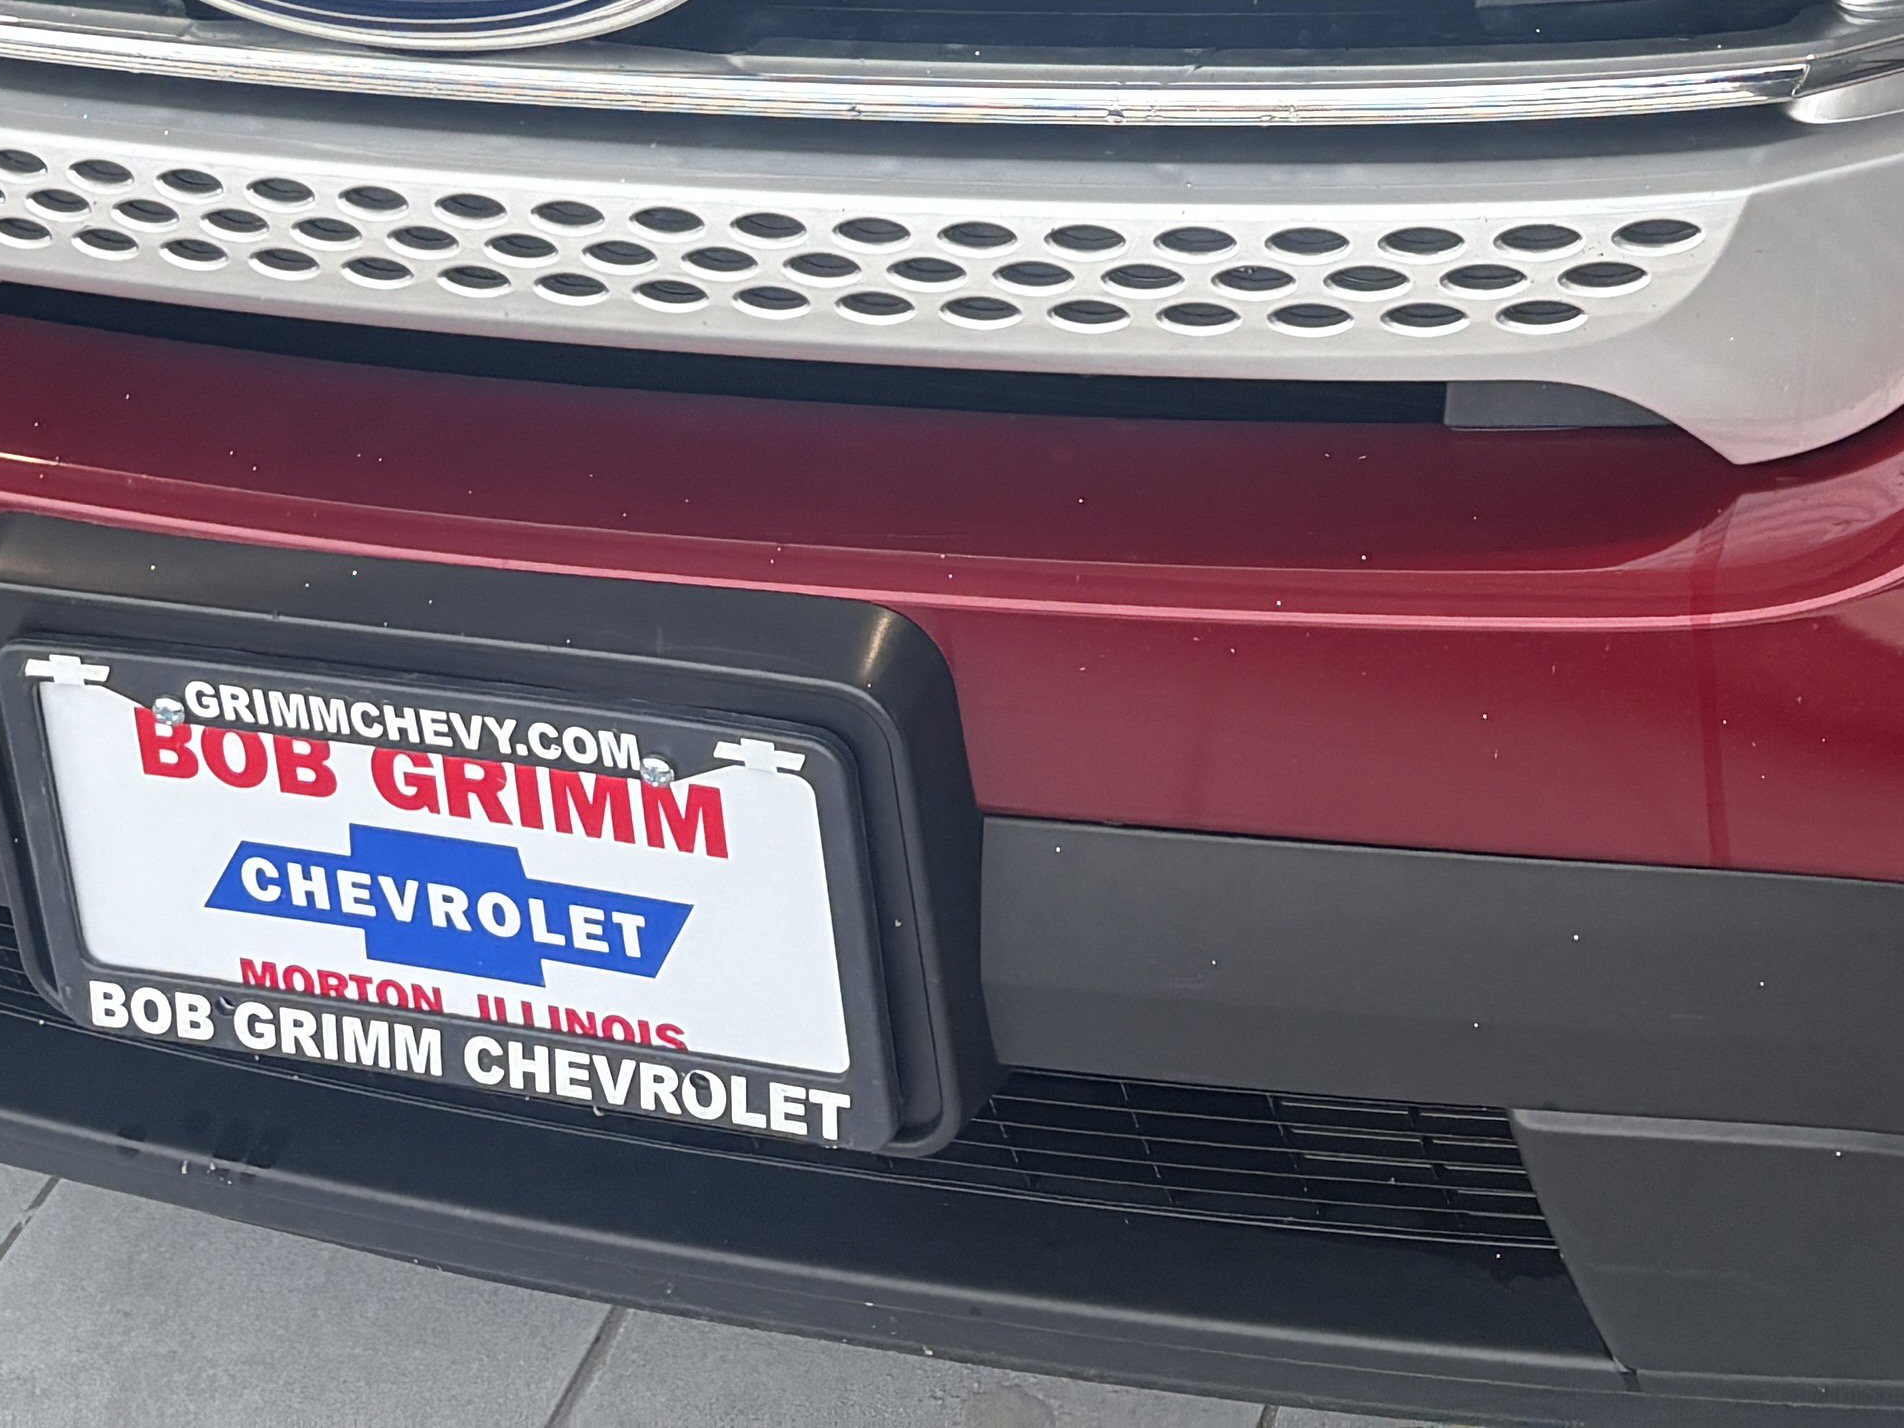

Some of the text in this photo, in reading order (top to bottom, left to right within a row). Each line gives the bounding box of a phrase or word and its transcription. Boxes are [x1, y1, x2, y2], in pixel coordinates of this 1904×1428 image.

[184, 679, 642, 771] GRIMMCHEVY.COM
[133, 706, 730, 860] BOB GRIMM
[239, 855, 647, 959] CHEVROLET
[239, 956, 689, 1053] MORTON ILLINOIS
[88, 979, 853, 1142] BOB GRIMM CHEVROLET
